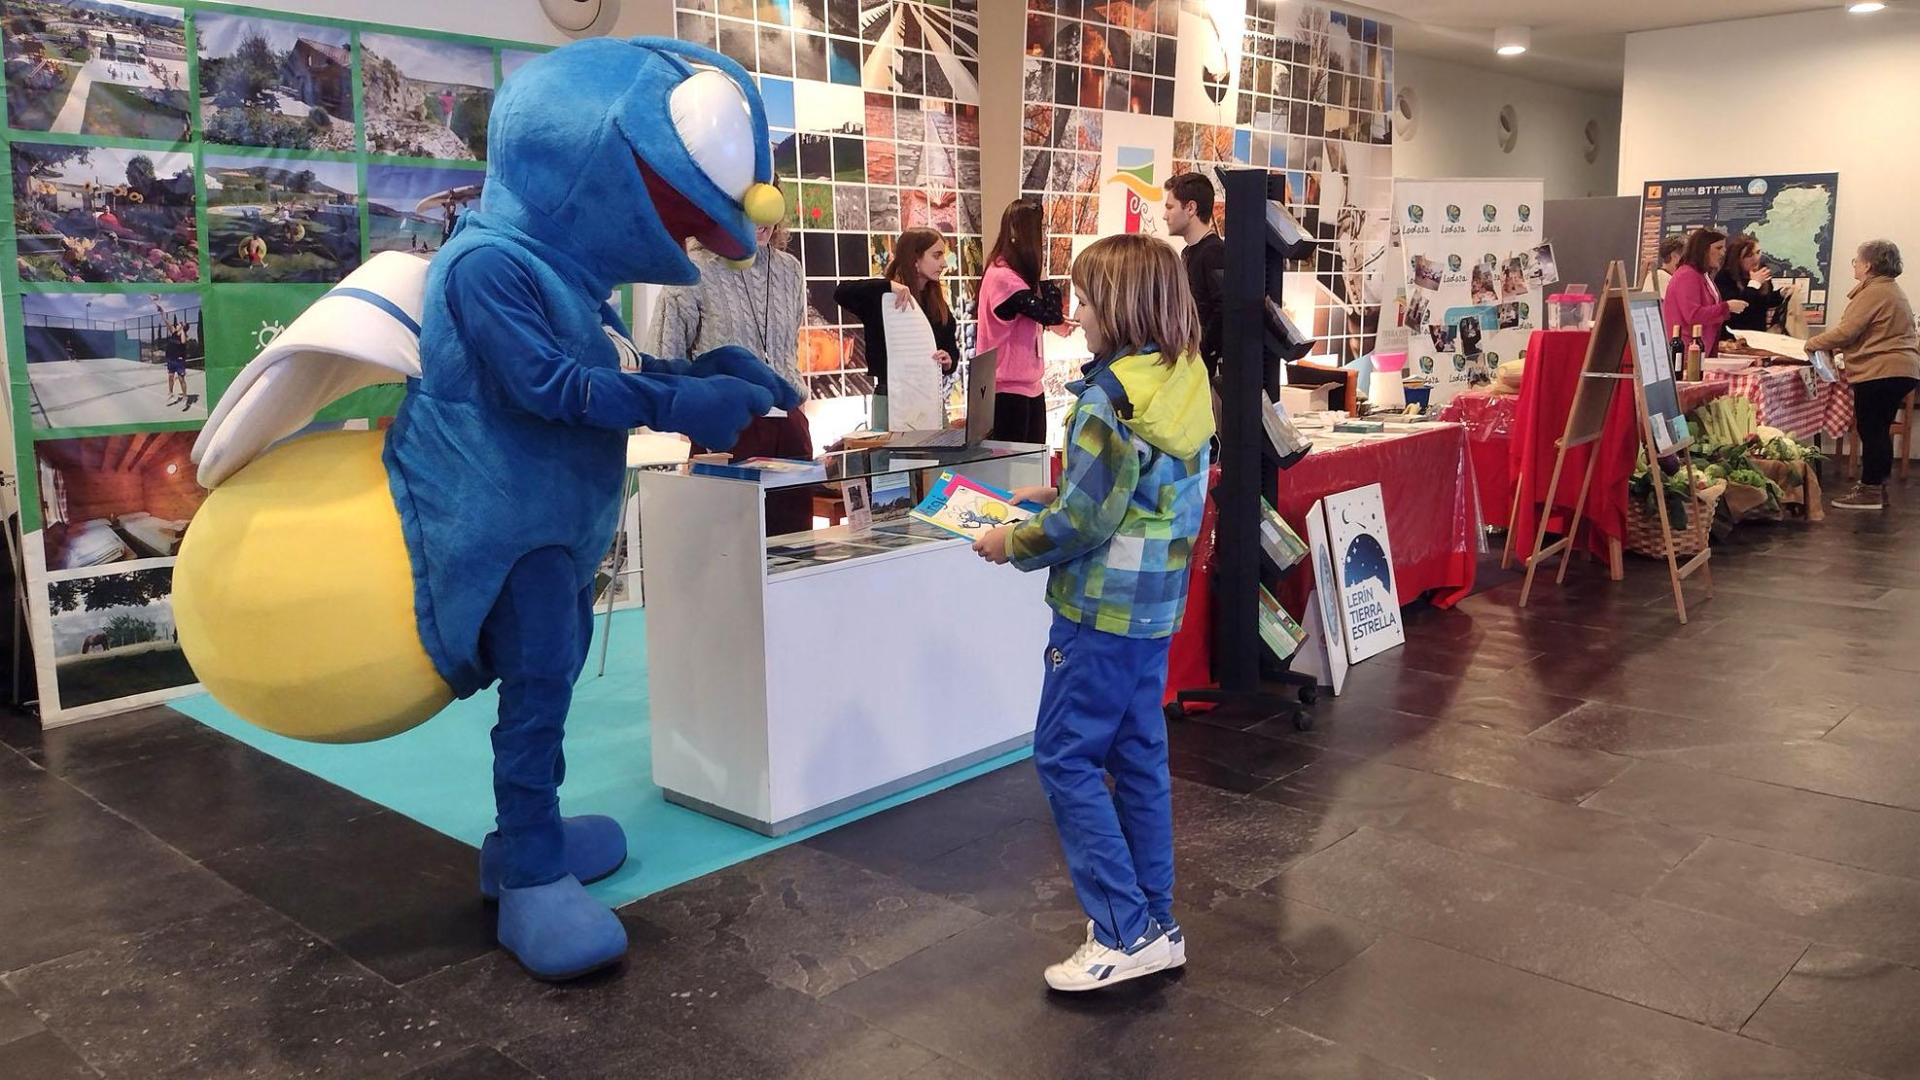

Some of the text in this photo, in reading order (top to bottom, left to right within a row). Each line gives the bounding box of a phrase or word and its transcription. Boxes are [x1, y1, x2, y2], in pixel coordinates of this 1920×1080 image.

[1697, 185, 1720, 195] BTT
[1346, 585, 1374, 609] LERÍN
[1349, 601, 1384, 625] TIERRA
[1352, 612, 1397, 641] ESTRELLA
